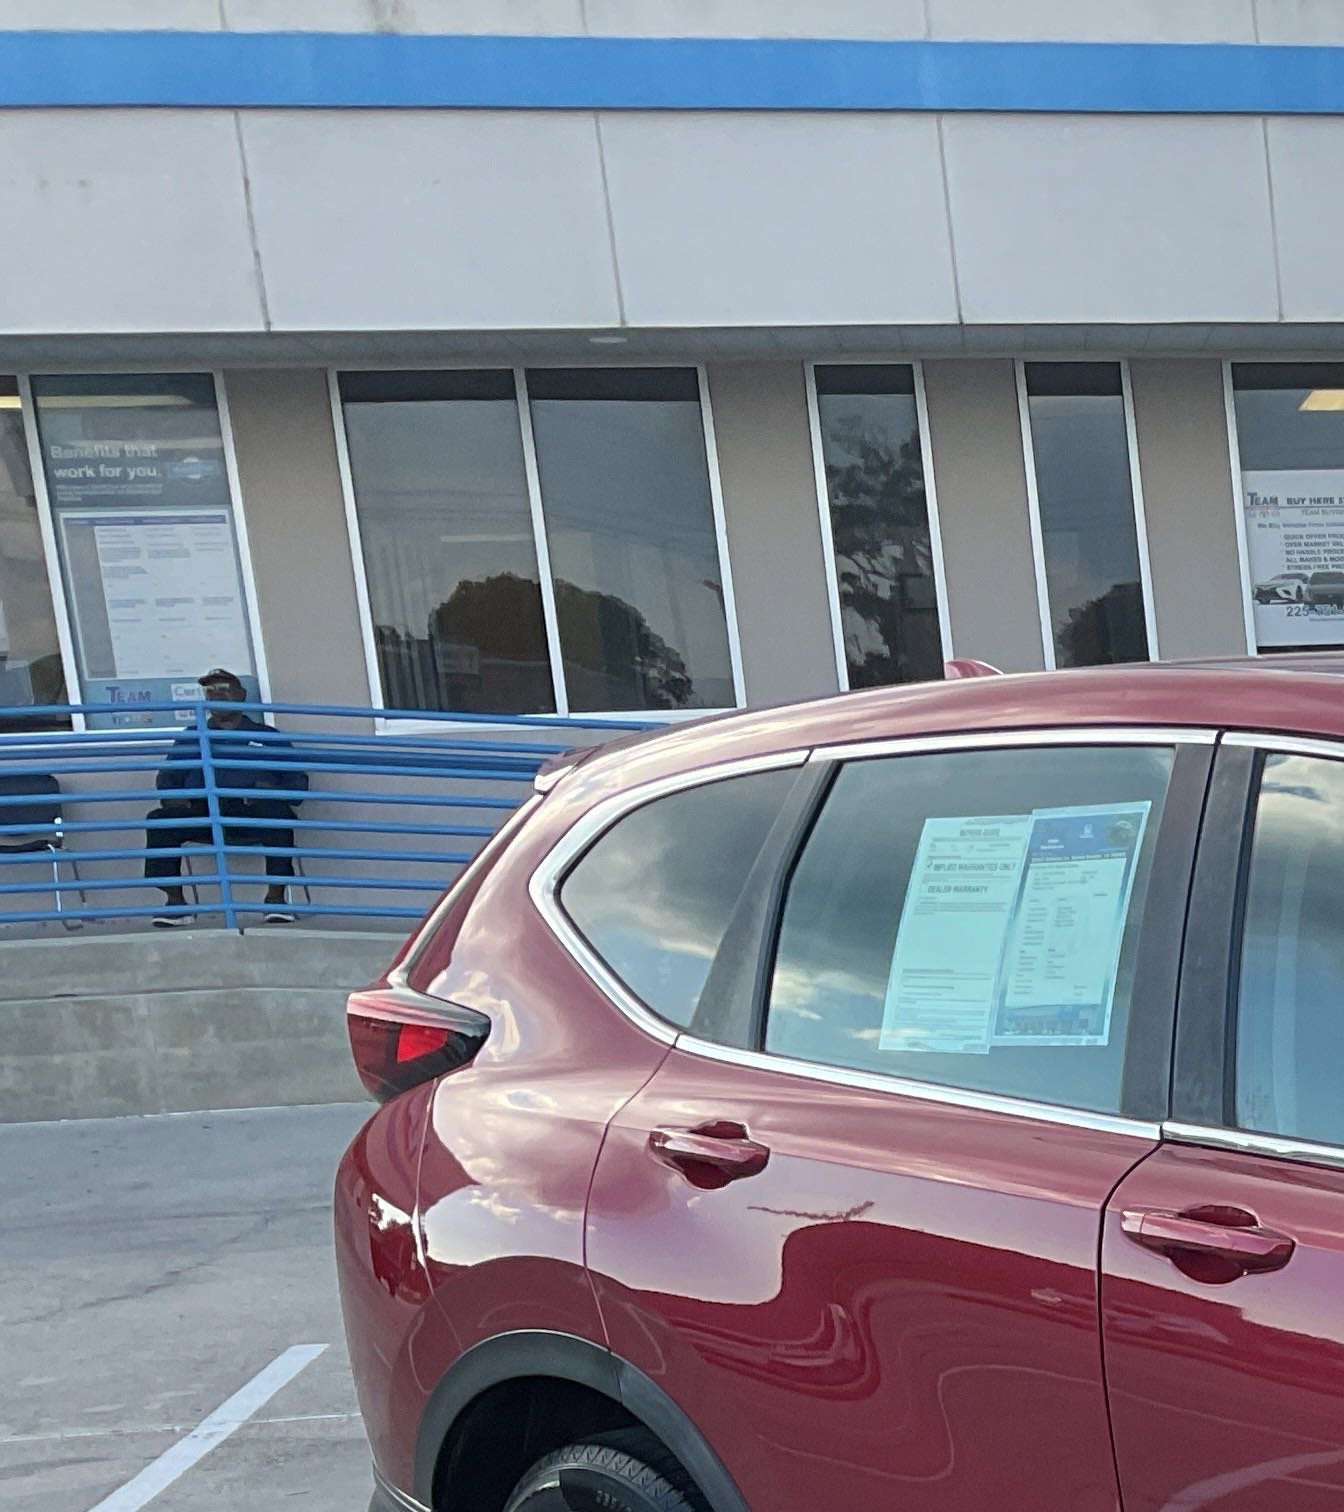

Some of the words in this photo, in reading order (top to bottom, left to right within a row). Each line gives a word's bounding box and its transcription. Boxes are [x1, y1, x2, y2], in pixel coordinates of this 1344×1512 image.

[51, 445, 121, 458] Benefits
[125, 444, 159, 458] that
[54, 465, 97, 478] work
[100, 464, 122, 478] for
[126, 466, 162, 480] you.
[1247, 492, 1279, 506] TEAM
[1286, 497, 1306, 505] BUY
[1309, 496, 1335, 505] HERE
[105, 686, 151, 703] TEAM
